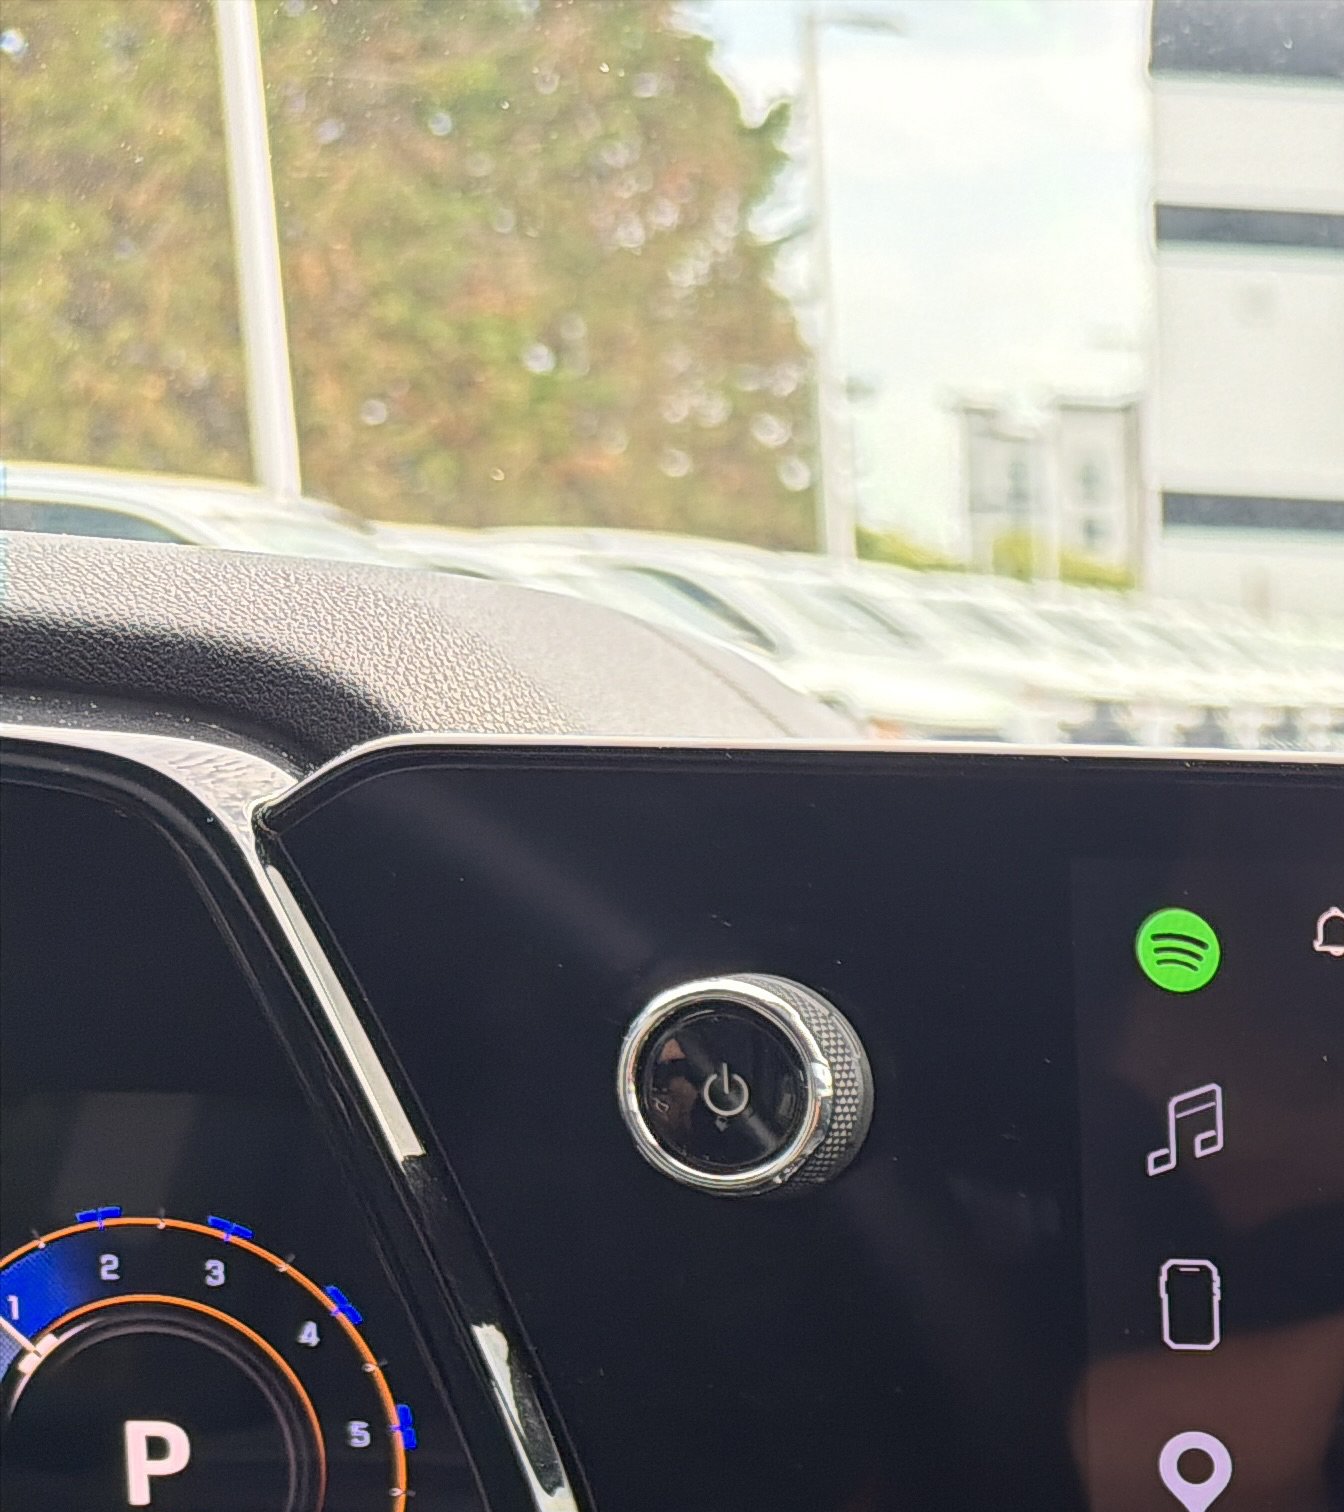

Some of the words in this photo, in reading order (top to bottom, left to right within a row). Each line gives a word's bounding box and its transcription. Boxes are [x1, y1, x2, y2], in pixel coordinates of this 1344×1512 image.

[100, 1253, 120, 1281] 2
[205, 1259, 225, 1287] 3
[6, 1294, 20, 1322] 1
[299, 1321, 320, 1347] 4
[349, 1420, 371, 1448] 5
[124, 1420, 191, 1506] P
